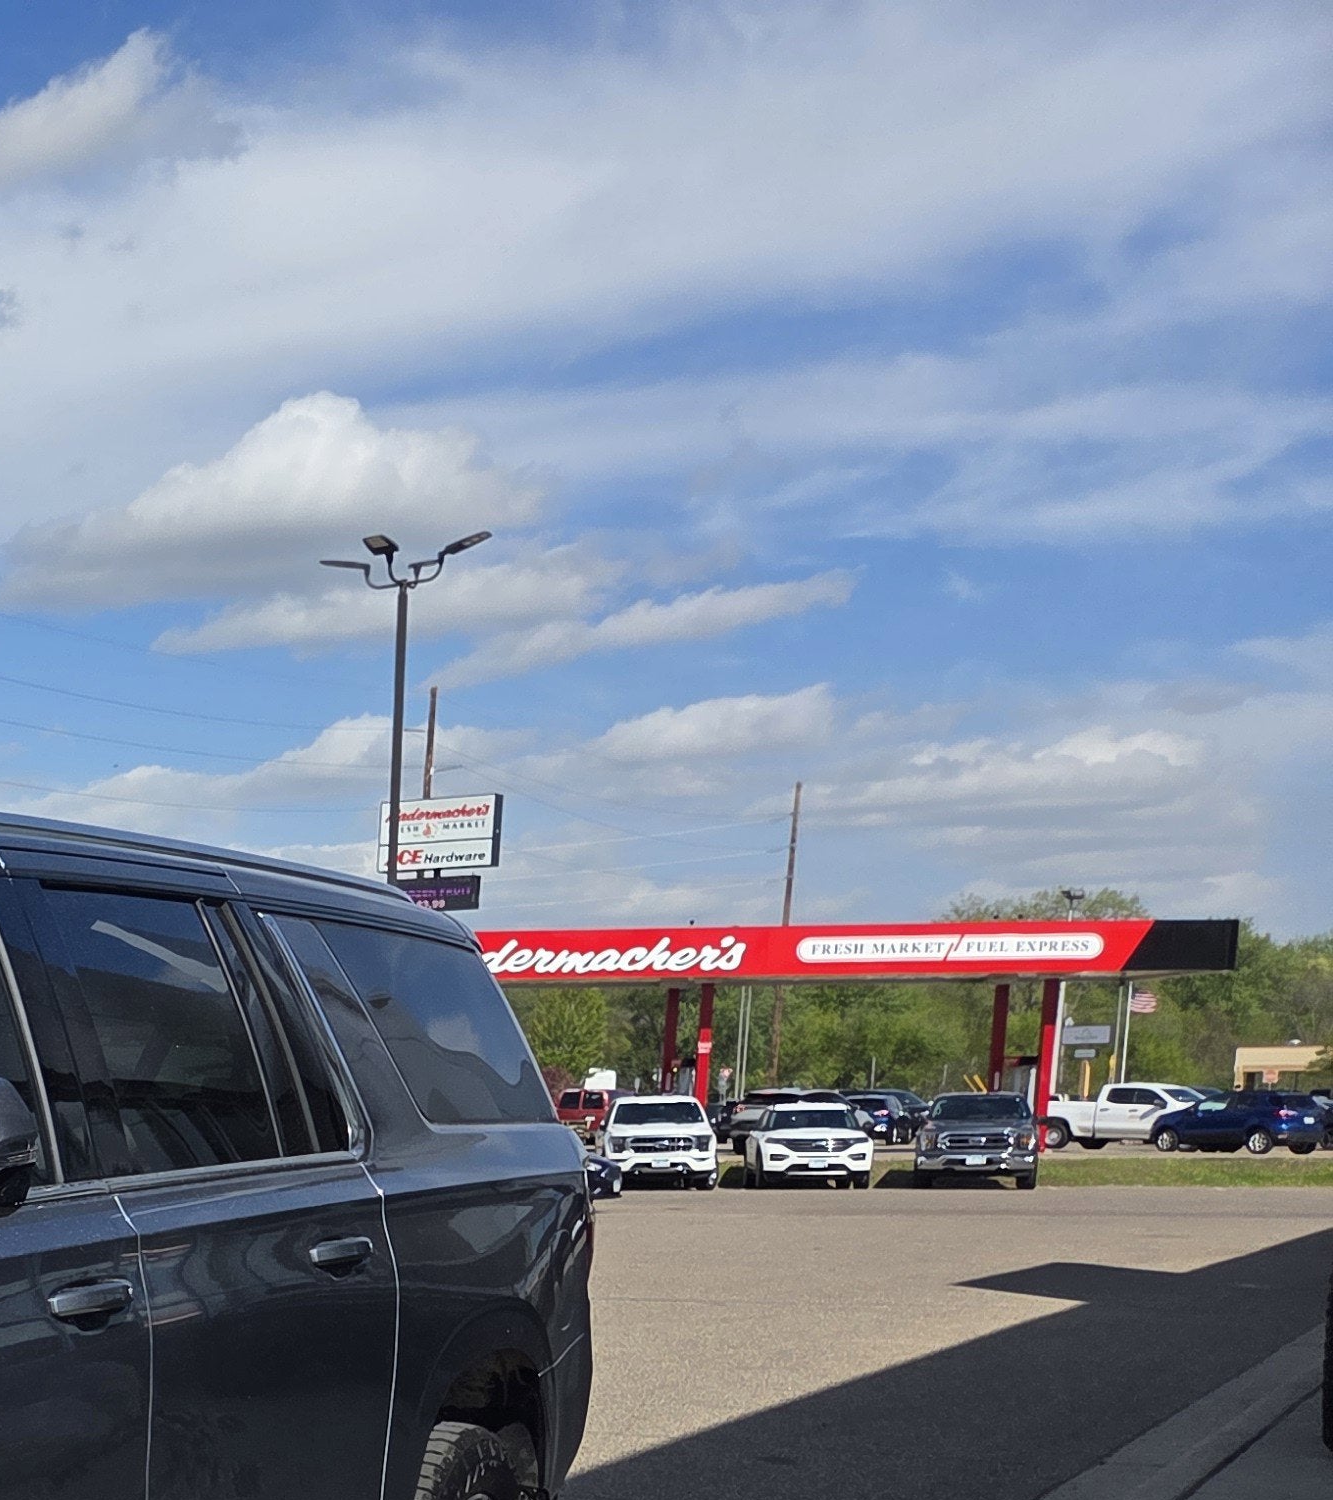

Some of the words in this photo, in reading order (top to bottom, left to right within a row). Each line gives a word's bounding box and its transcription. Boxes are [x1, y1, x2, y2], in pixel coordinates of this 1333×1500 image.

[443, 820, 485, 829] MARKET
[393, 850, 424, 865] CE
[424, 852, 486, 863] Hardware
[812, 943, 864, 955] FRESH
[872, 942, 945, 954] MARKET
[966, 941, 1008, 953] FUEL
[1016, 940, 1089, 952] EXPRESS
